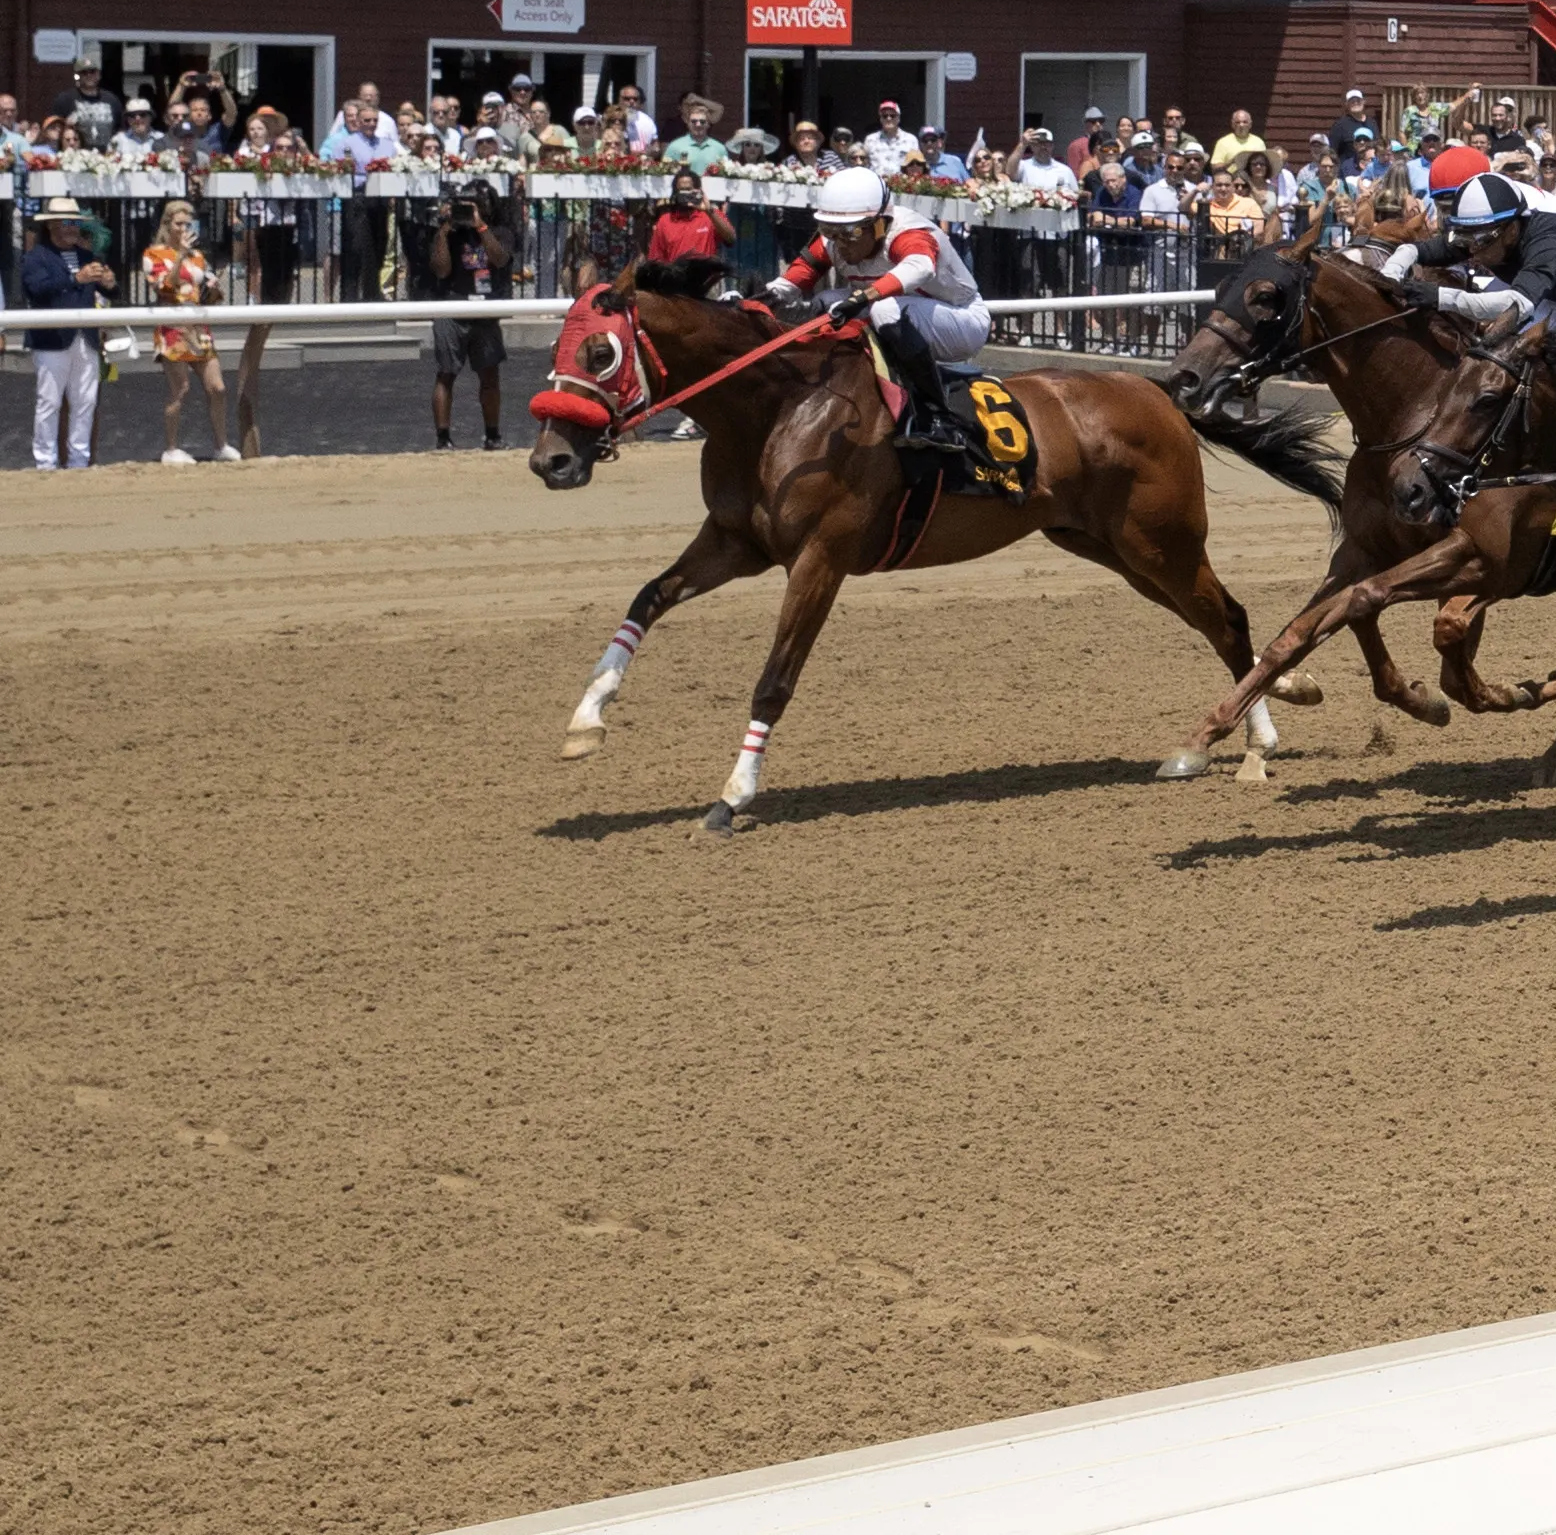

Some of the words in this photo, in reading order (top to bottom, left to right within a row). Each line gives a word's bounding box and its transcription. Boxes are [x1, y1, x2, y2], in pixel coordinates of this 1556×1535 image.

[514, 9, 548, 22] Access
[550, 10, 573, 25] Only
[751, 6, 848, 28] SARATOGA
[969, 381, 1028, 462] 6
